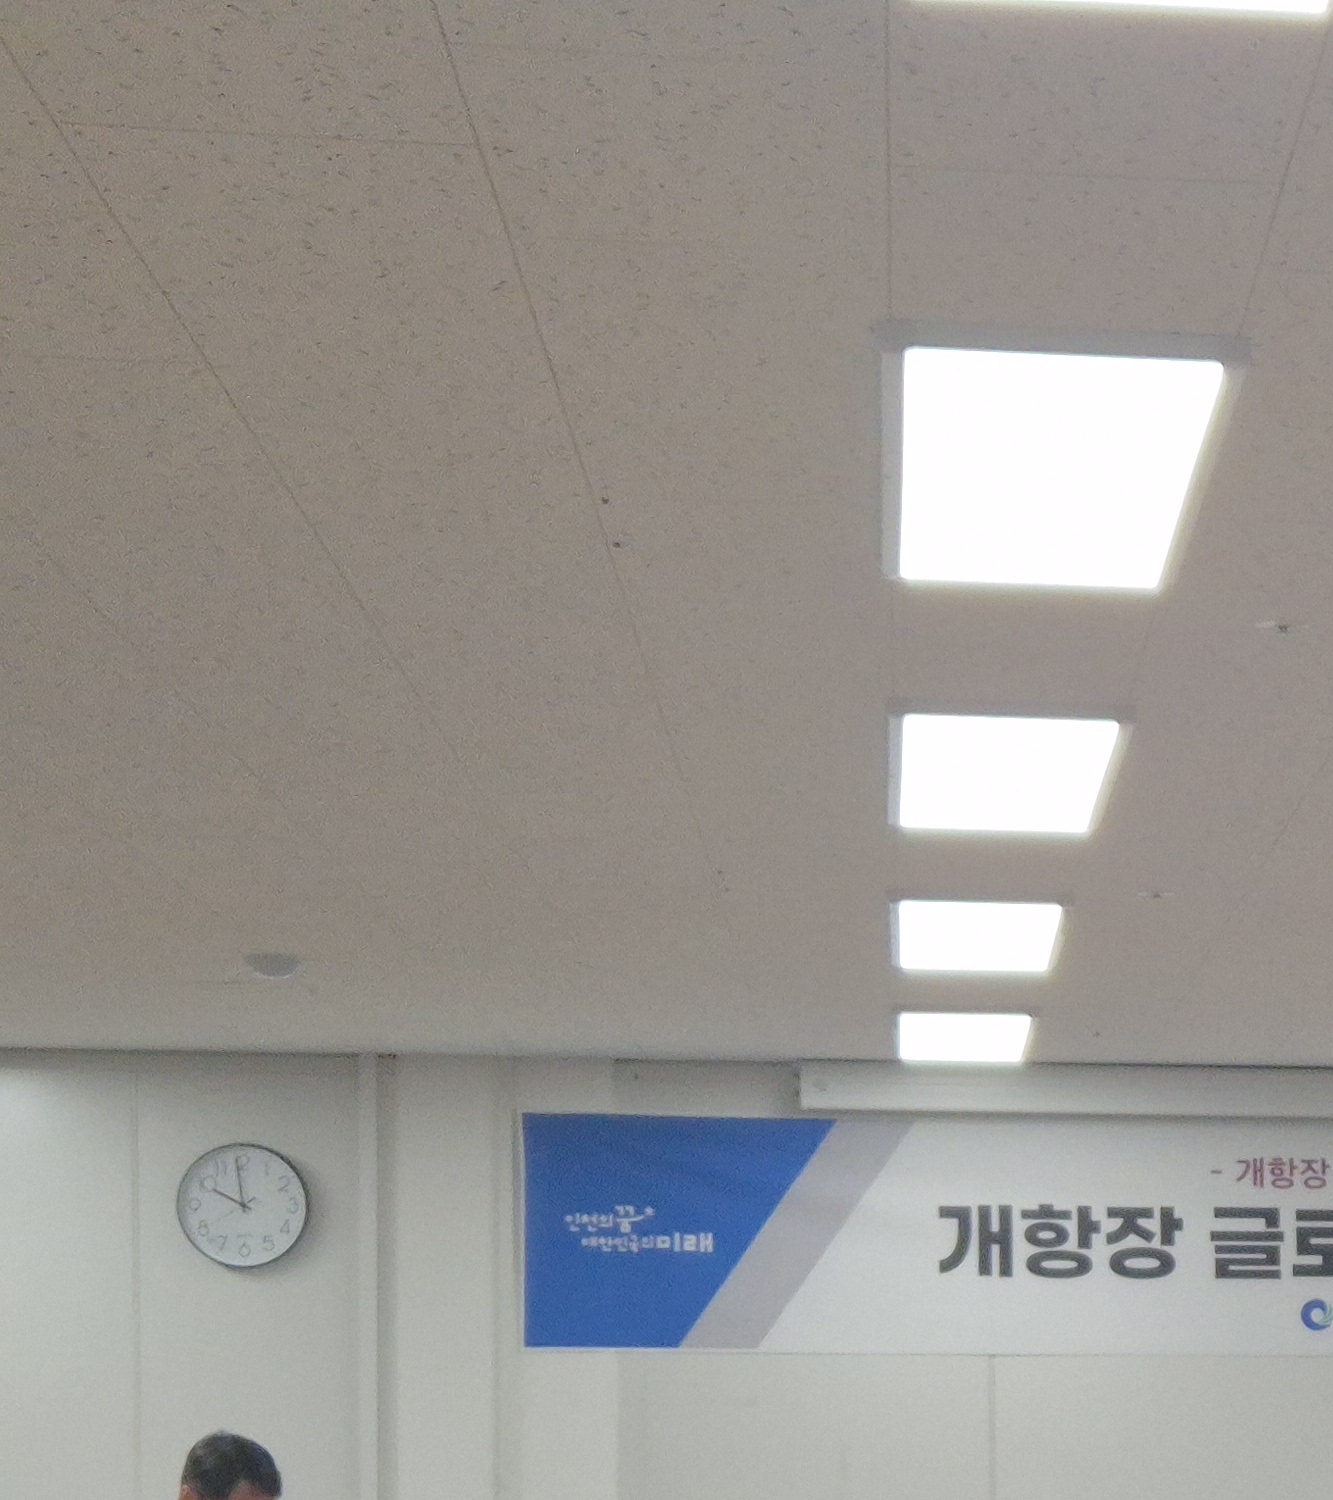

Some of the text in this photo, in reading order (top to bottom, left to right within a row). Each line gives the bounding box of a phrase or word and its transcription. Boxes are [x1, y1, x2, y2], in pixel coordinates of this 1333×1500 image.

[1235, 1156, 1331, 1190] 개항장
[277, 1175, 291, 1193] 2
[285, 1196, 299, 1215] 3
[198, 1219, 209, 1237] 8
[279, 1218, 291, 1235] 4
[216, 1234, 229, 1252] 7
[238, 1240, 251, 1258] 6
[262, 1234, 275, 1252] 5
[655, 1231, 714, 1253] 미래
[938, 1204, 1184, 1280] 개항장
